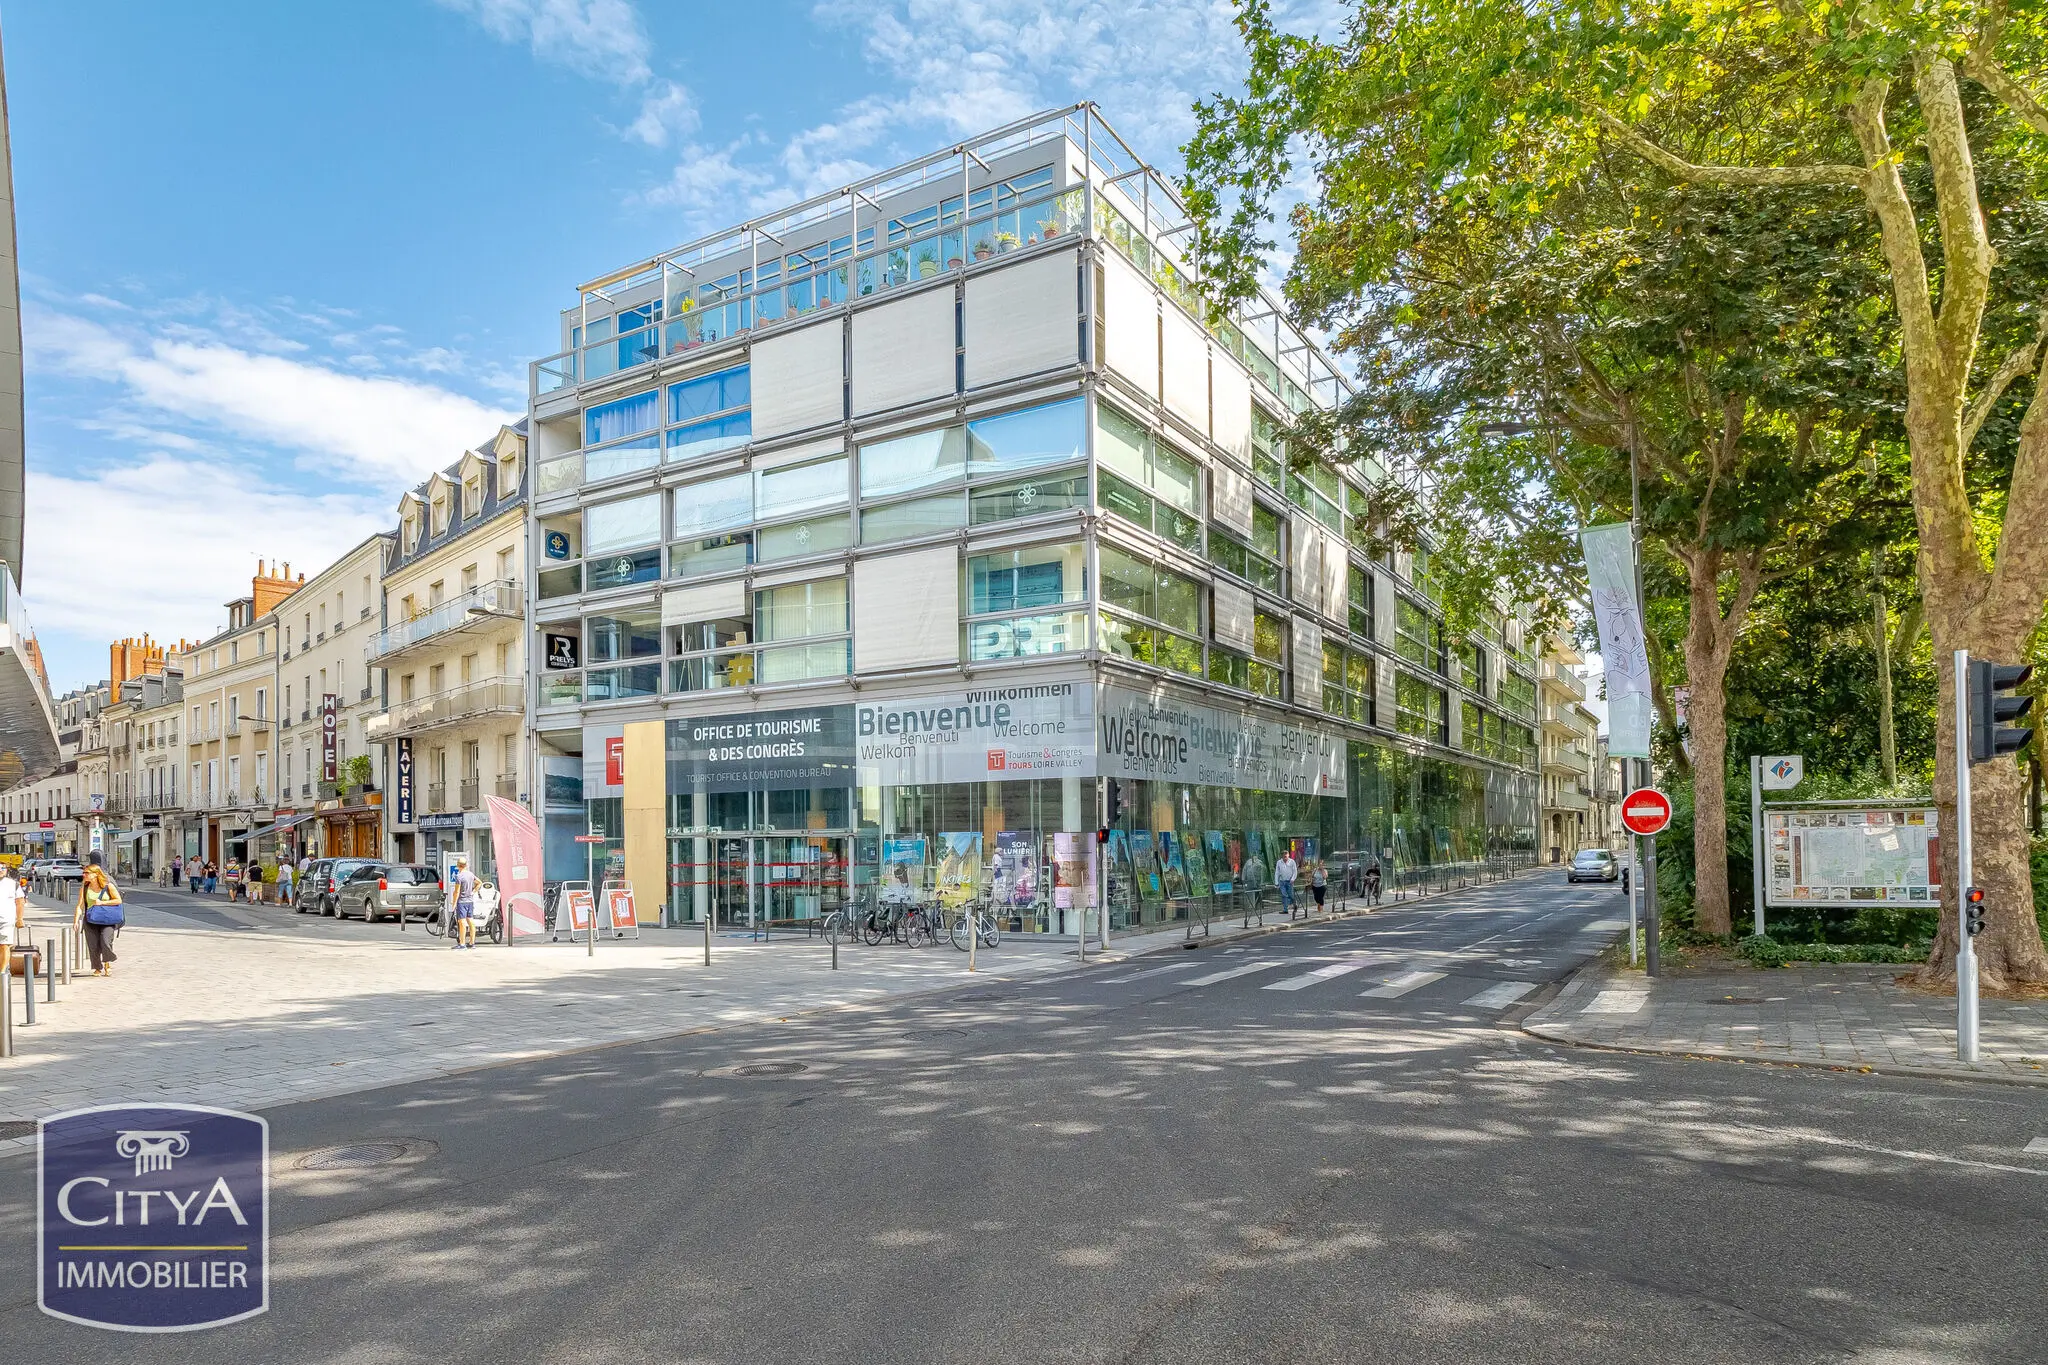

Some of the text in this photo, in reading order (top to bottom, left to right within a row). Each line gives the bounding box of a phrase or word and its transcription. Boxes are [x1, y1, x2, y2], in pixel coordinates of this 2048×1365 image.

[549, 655, 575, 665] PRELYS
[859, 703, 1011, 736] Bienvenue
[1149, 702, 1189, 727] Benvenuti
[323, 696, 336, 781] HOTEL
[694, 718, 821, 741] OFFICE DE TOURISME
[900, 729, 959, 746] Benvenuti
[994, 720, 1065, 738] Welcome
[1102, 714, 1187, 763] Welcome
[709, 739, 805, 761] & DES CONGRÈS
[861, 745, 916, 760] Welkom
[1034, 760, 1054, 768] LOIRE
[1055, 759, 1082, 767] VALLEY
[400, 739, 410, 822] LAVERIE
[686, 767, 831, 784] TOURIST OFFICE & CONVENTION BUREAU
[1199, 764, 1236, 785] Bienvenue
[419, 817, 436, 826] LAVERIE
[436, 816, 463, 826] AUTOMATIQUE
